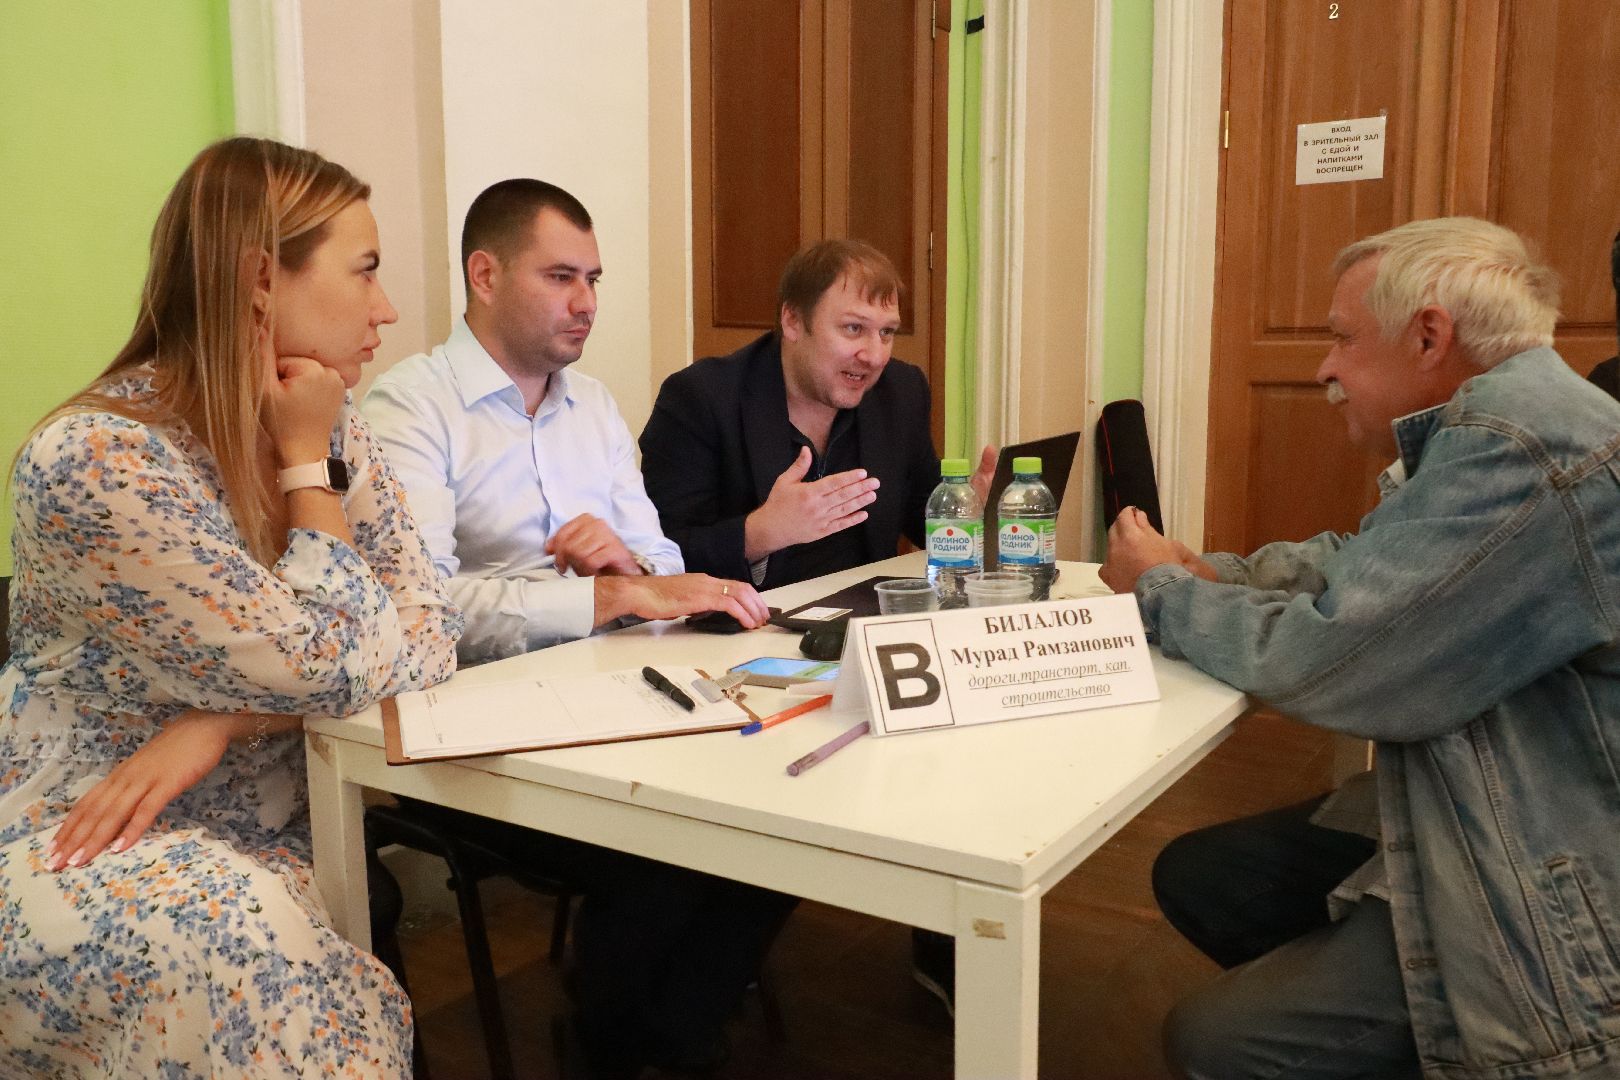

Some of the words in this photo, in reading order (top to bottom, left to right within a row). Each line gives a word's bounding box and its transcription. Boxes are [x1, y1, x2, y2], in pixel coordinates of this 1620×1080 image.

[1328, 3, 1339, 20] 2
[1331, 126, 1352, 134] ВХОД
[1312, 135, 1361, 146] ЗРИТЕЛЬНЫЙ
[1364, 133, 1379, 141] ЗАЛ
[1329, 145, 1351, 154] ЕДОЙ
[1317, 155, 1363, 164] НАПИТКАМИ
[1316, 164, 1364, 174] ВОСПРЕЩЕН
[933, 544, 968, 552] РОДНИК
[983, 607, 1094, 635] БИЛАЛОВ
[950, 645, 1019, 669] Мурад
[1023, 634, 1136, 659] Рамзанович
[875, 641, 942, 711] В
[1001, 682, 1112, 707] строительство
